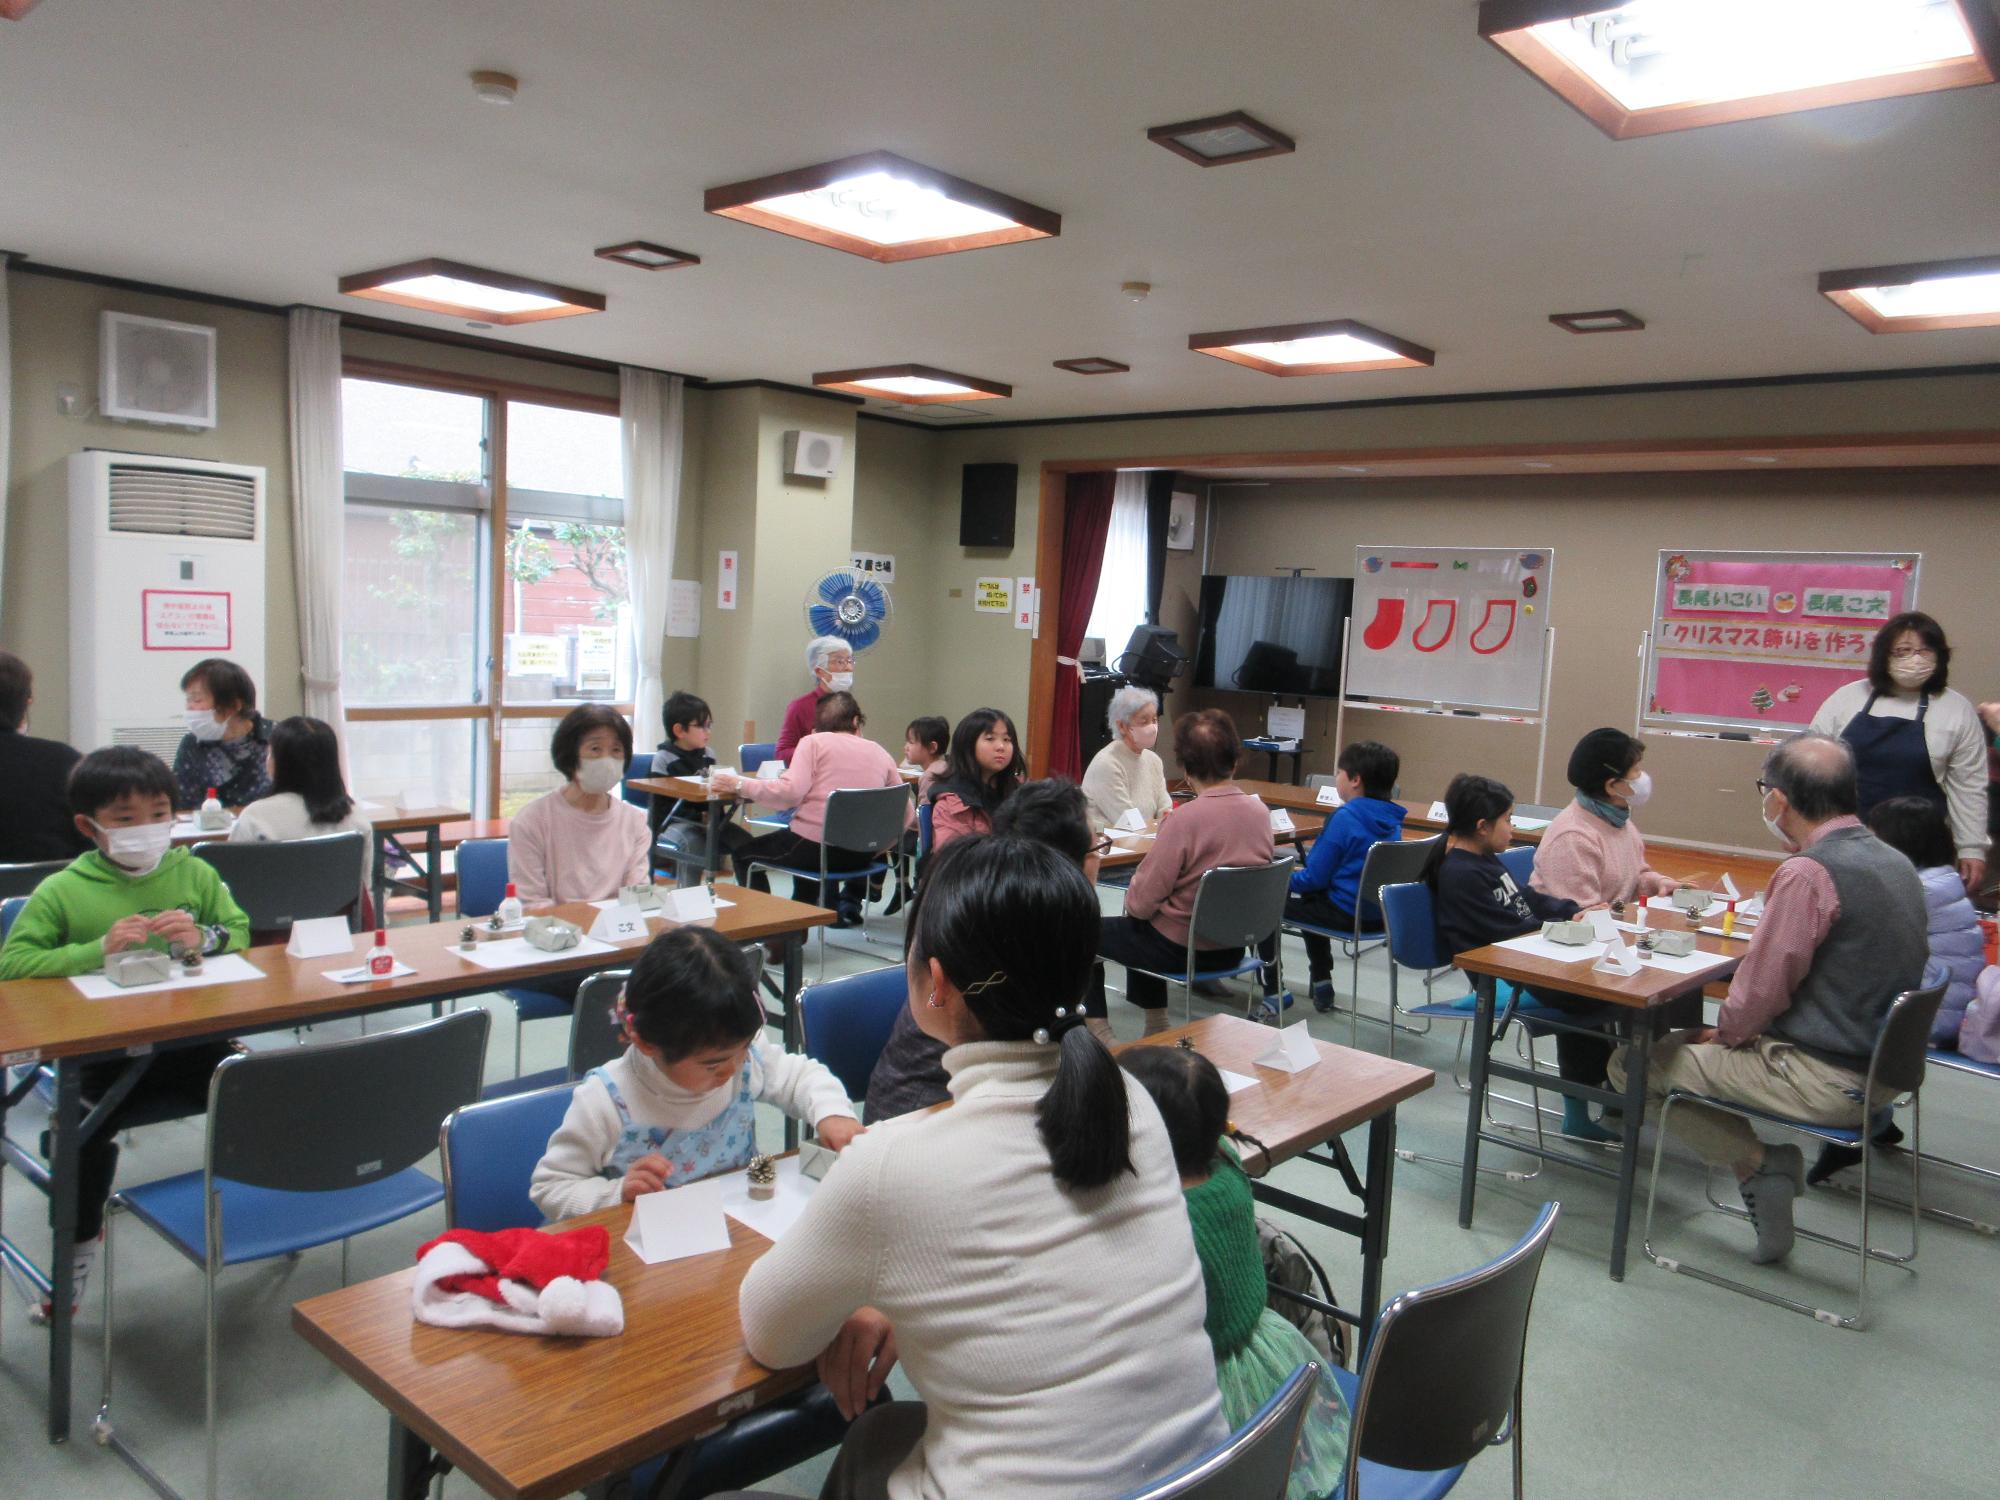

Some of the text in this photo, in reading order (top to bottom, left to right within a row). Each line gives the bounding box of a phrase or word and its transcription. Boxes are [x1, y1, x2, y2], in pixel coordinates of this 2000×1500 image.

[850, 559, 892, 573] ス置き場
[1678, 589, 1762, 608] 長尾いこい
[1806, 594, 1886, 613] 長尾こ文
[1663, 623, 1873, 654] 「クリスマス飾りを作ろ
